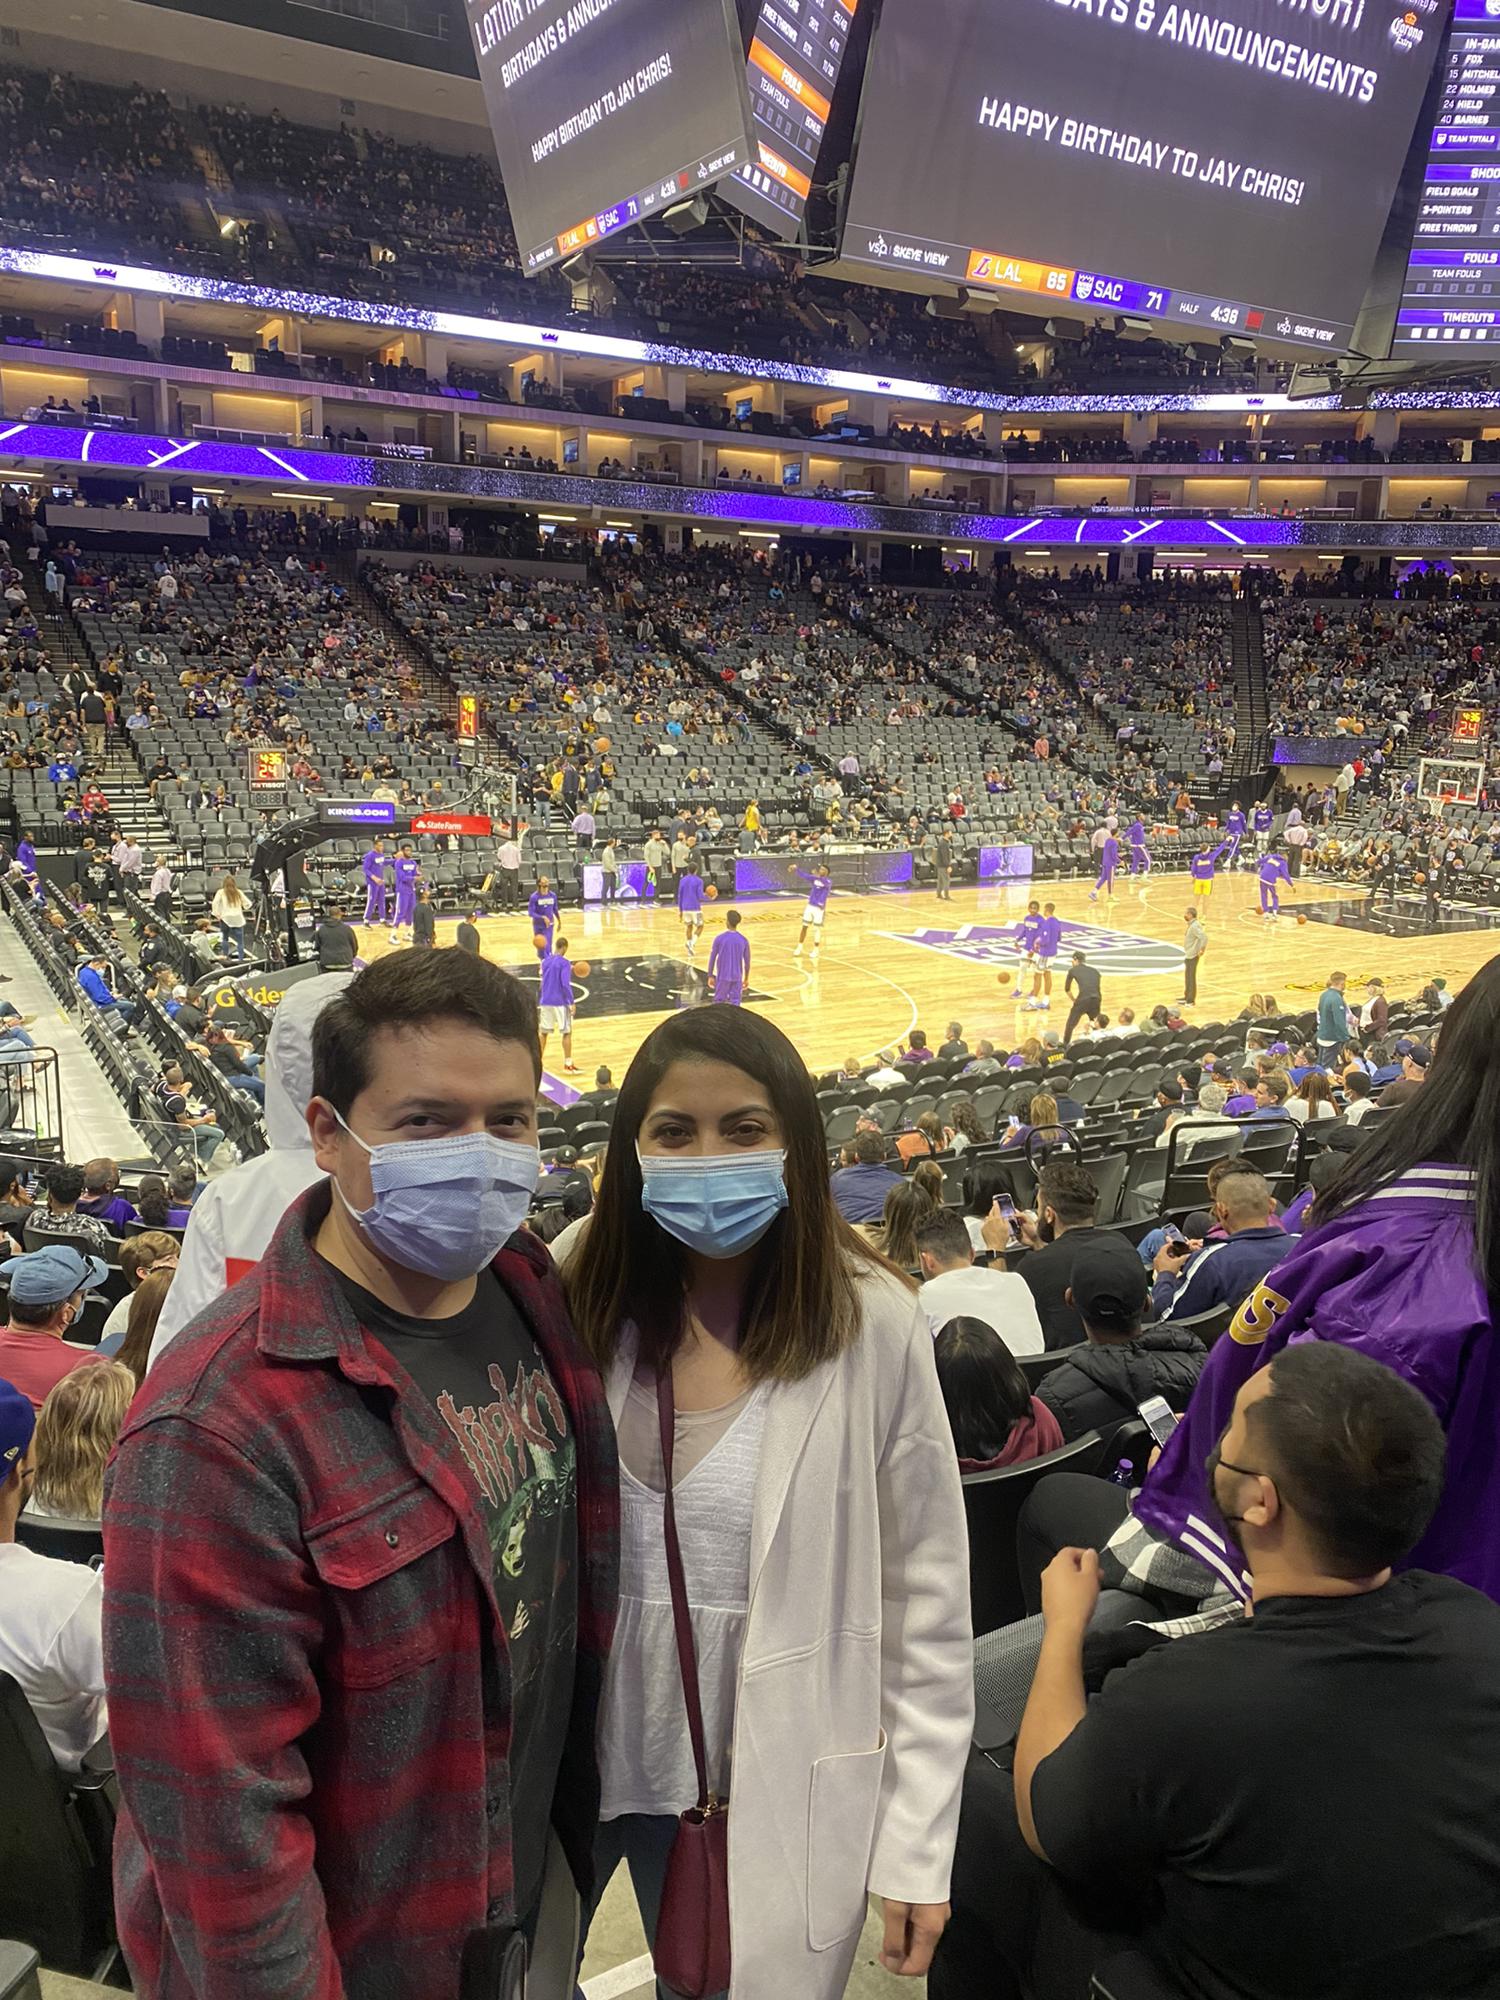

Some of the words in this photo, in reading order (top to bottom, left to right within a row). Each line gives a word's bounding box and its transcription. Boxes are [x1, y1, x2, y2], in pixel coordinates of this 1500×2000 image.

[1391, 16, 1424, 42] Corona
[500, 25, 558, 89] BIRTHDAYS
[556, 18, 567, 44] &
[1158, 4, 1378, 102] ANNOUNCEMENTS
[1464, 54, 1485, 65] FOX
[1449, 69, 1459, 79] 15
[781, 67, 803, 95] FOULS
[759, 76, 774, 97] TEAM
[772, 87, 790, 110] FOULS
[1446, 85, 1458, 94] 22
[1459, 85, 1497, 95] HOLMES
[531, 129, 559, 163] HAPPY
[558, 100, 602, 145] BIRTHDAY
[601, 90, 617, 116] TO
[617, 76, 636, 107] JAY
[635, 52, 673, 94] CHRIS!
[1443, 100, 1455, 109] 24
[1456, 99, 1484, 110] HIELD
[1440, 115, 1452, 124] 40
[1453, 115, 1490, 125] BARNES
[1447, 134, 1468, 143] TEAM
[1468, 134, 1496, 143] TOTALS
[978, 96, 1059, 141] HAPPY
[1060, 118, 1170, 170] BIRTHDAY
[1171, 147, 1199, 179] TO
[1199, 157, 1242, 189] JAY
[1240, 167, 1305, 206] CHRIS!
[1425, 187, 1450, 197] FIELD
[1450, 187, 1480, 197] GOALS
[605, 209, 620, 228] SAC
[628, 200, 638, 217] 71
[1422, 205, 1473, 215] 3-POINTERS
[1419, 223, 1441, 233] FREE
[1442, 223, 1478, 233] THROWS
[892, 244, 922, 263] SKEYE
[923, 251, 949, 267] VIEW
[1463, 252, 1499, 264] FOULS
[994, 260, 1023, 283] LAL
[1432, 269, 1454, 278] TEAM
[1454, 269, 1482, 279] FOULS
[1093, 280, 1124, 302] SAC
[1145, 291, 1164, 311] 71
[1179, 302, 1200, 314] HALF
[1442, 312, 1495, 323] TIMEOUTS
[461, 712, 474, 734] 24
[1459, 721, 1477, 736] 24
[259, 764, 277, 778] 24
[327, 807, 389, 817] KINGS.COM
